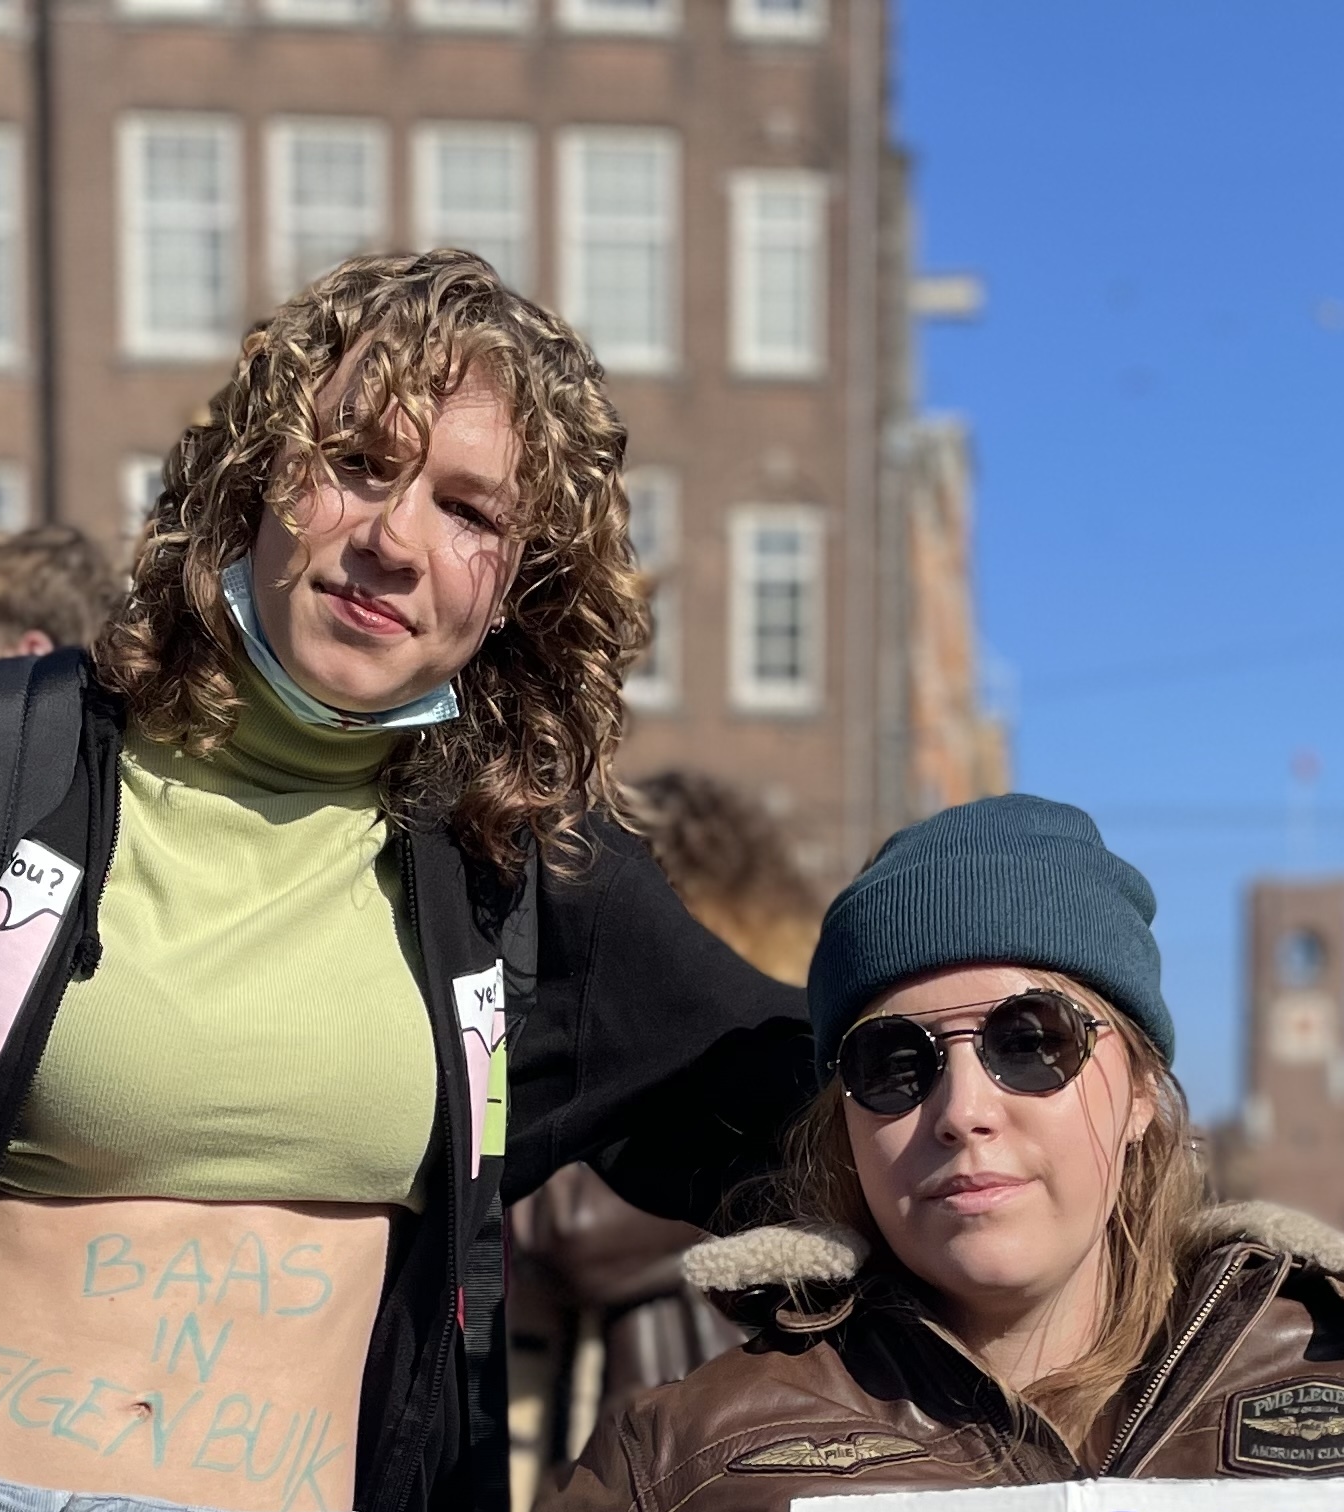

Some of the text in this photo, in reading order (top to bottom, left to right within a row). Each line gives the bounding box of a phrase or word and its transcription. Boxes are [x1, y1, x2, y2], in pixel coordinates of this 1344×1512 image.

[82, 1230, 333, 1316] BAAS
[150, 1311, 233, 1383] IN
[1253, 1391, 1294, 1416] PME
[1251, 1444, 1315, 1460] AMERICAN
